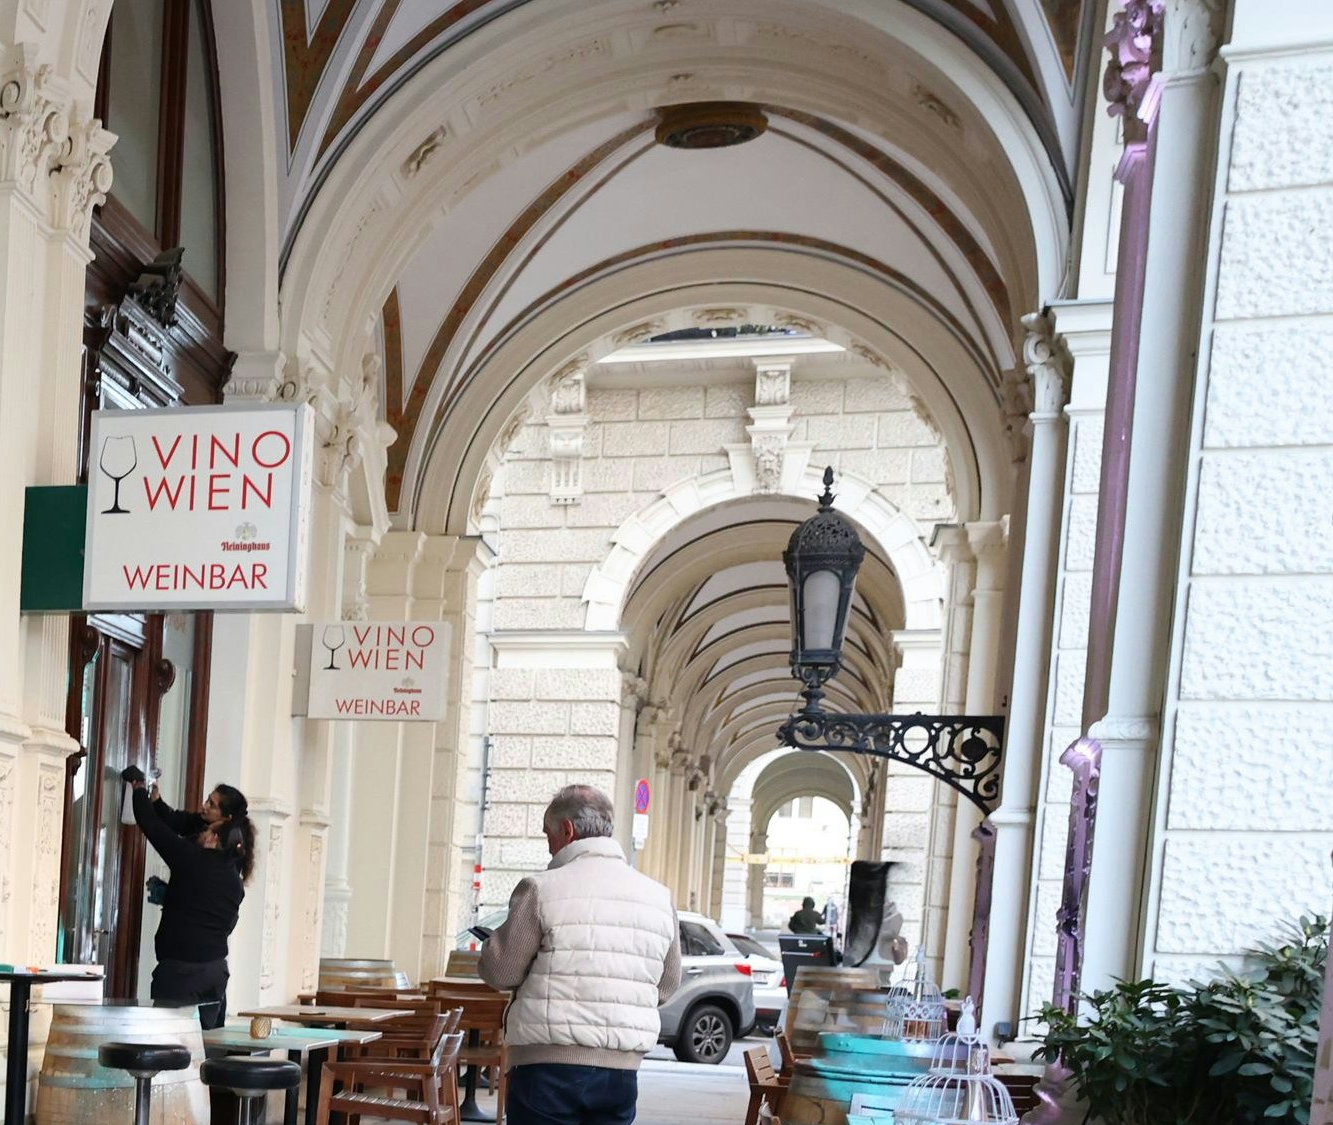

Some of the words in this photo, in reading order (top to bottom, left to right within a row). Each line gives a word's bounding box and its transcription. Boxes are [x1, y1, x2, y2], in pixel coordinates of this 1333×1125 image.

[151, 430, 291, 470] VINO
[143, 473, 273, 511] WIEN
[123, 563, 268, 591] WEINBAR
[353, 625, 435, 648] VINO
[348, 648, 424, 670] WIEN
[335, 699, 421, 716] WEINBAR
